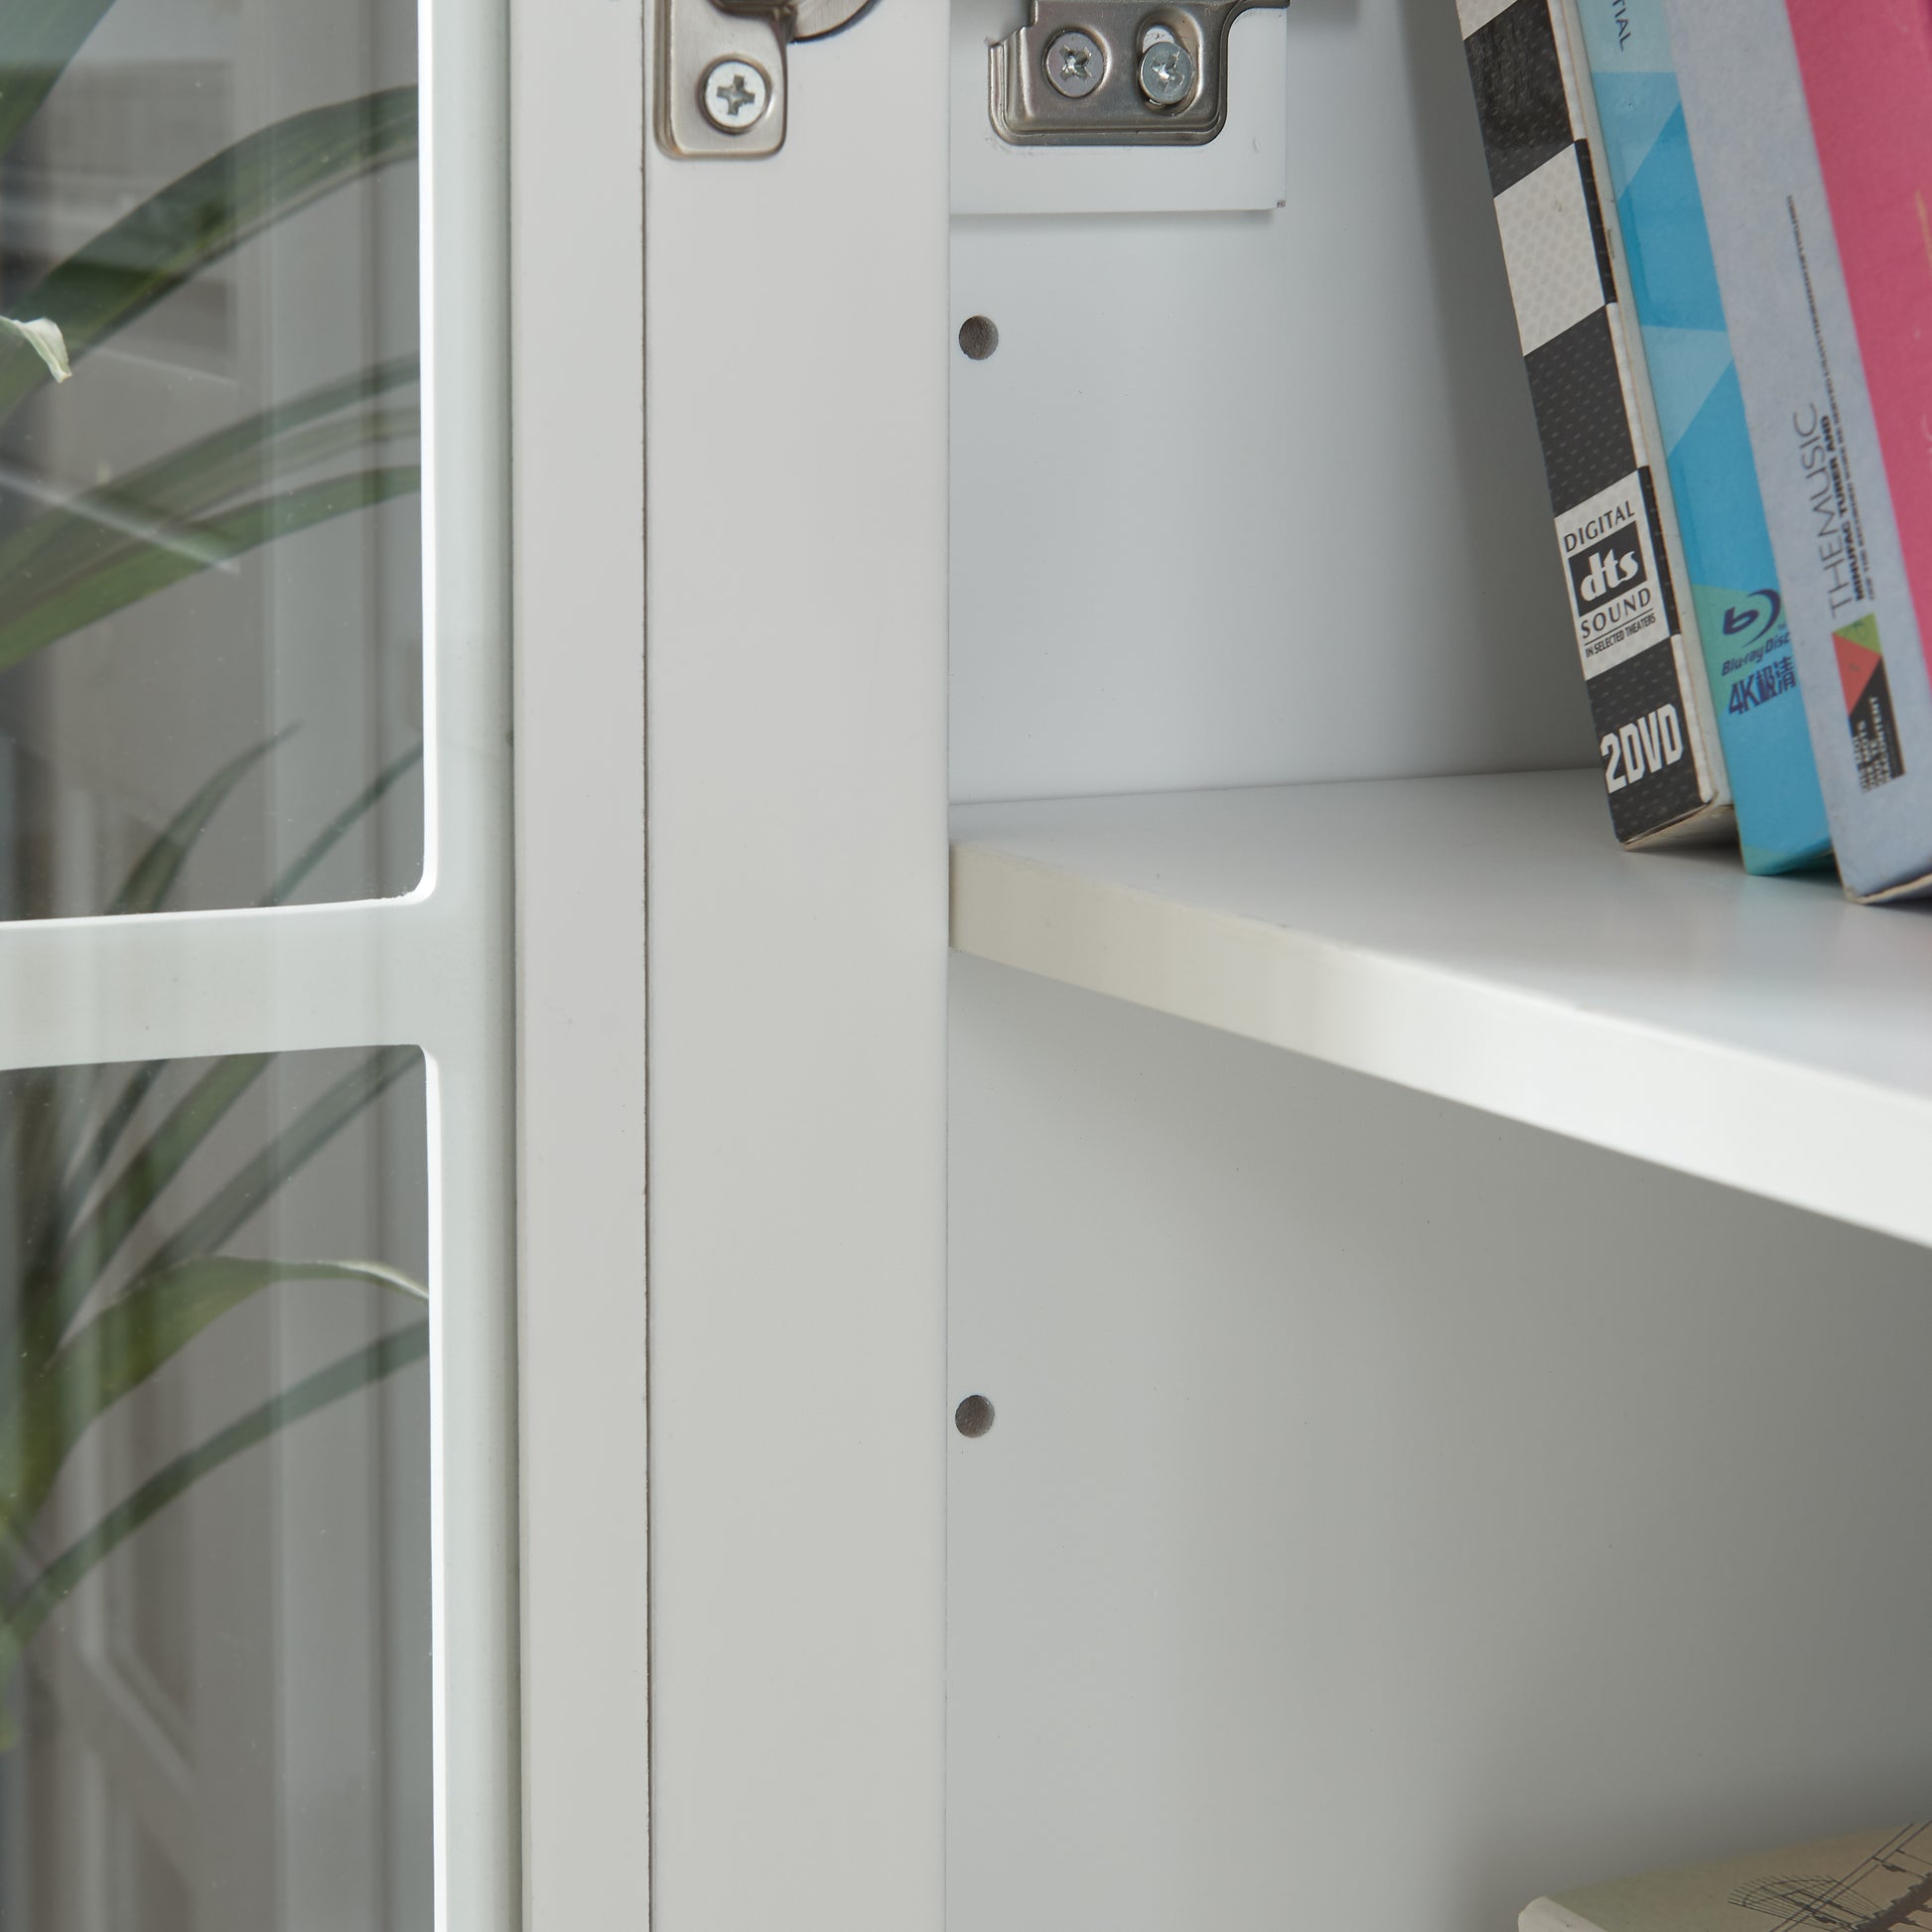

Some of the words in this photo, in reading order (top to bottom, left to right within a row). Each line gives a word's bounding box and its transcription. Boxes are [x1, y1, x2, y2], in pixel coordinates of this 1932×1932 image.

[1821, 415, 1836, 452] AND
[1564, 500, 1634, 552] DIGITAL
[1793, 402, 1853, 620] THEMUSIC
[1581, 548, 1638, 601] dts
[1581, 588, 1651, 639] SOUND
[1585, 646, 1595, 658] IN
[1593, 629, 1625, 654] SELECTED
[1624, 613, 1656, 637] THEATERS
[1722, 646, 1764, 676] Blu-ray
[1600, 703, 1684, 794] 2DVD
